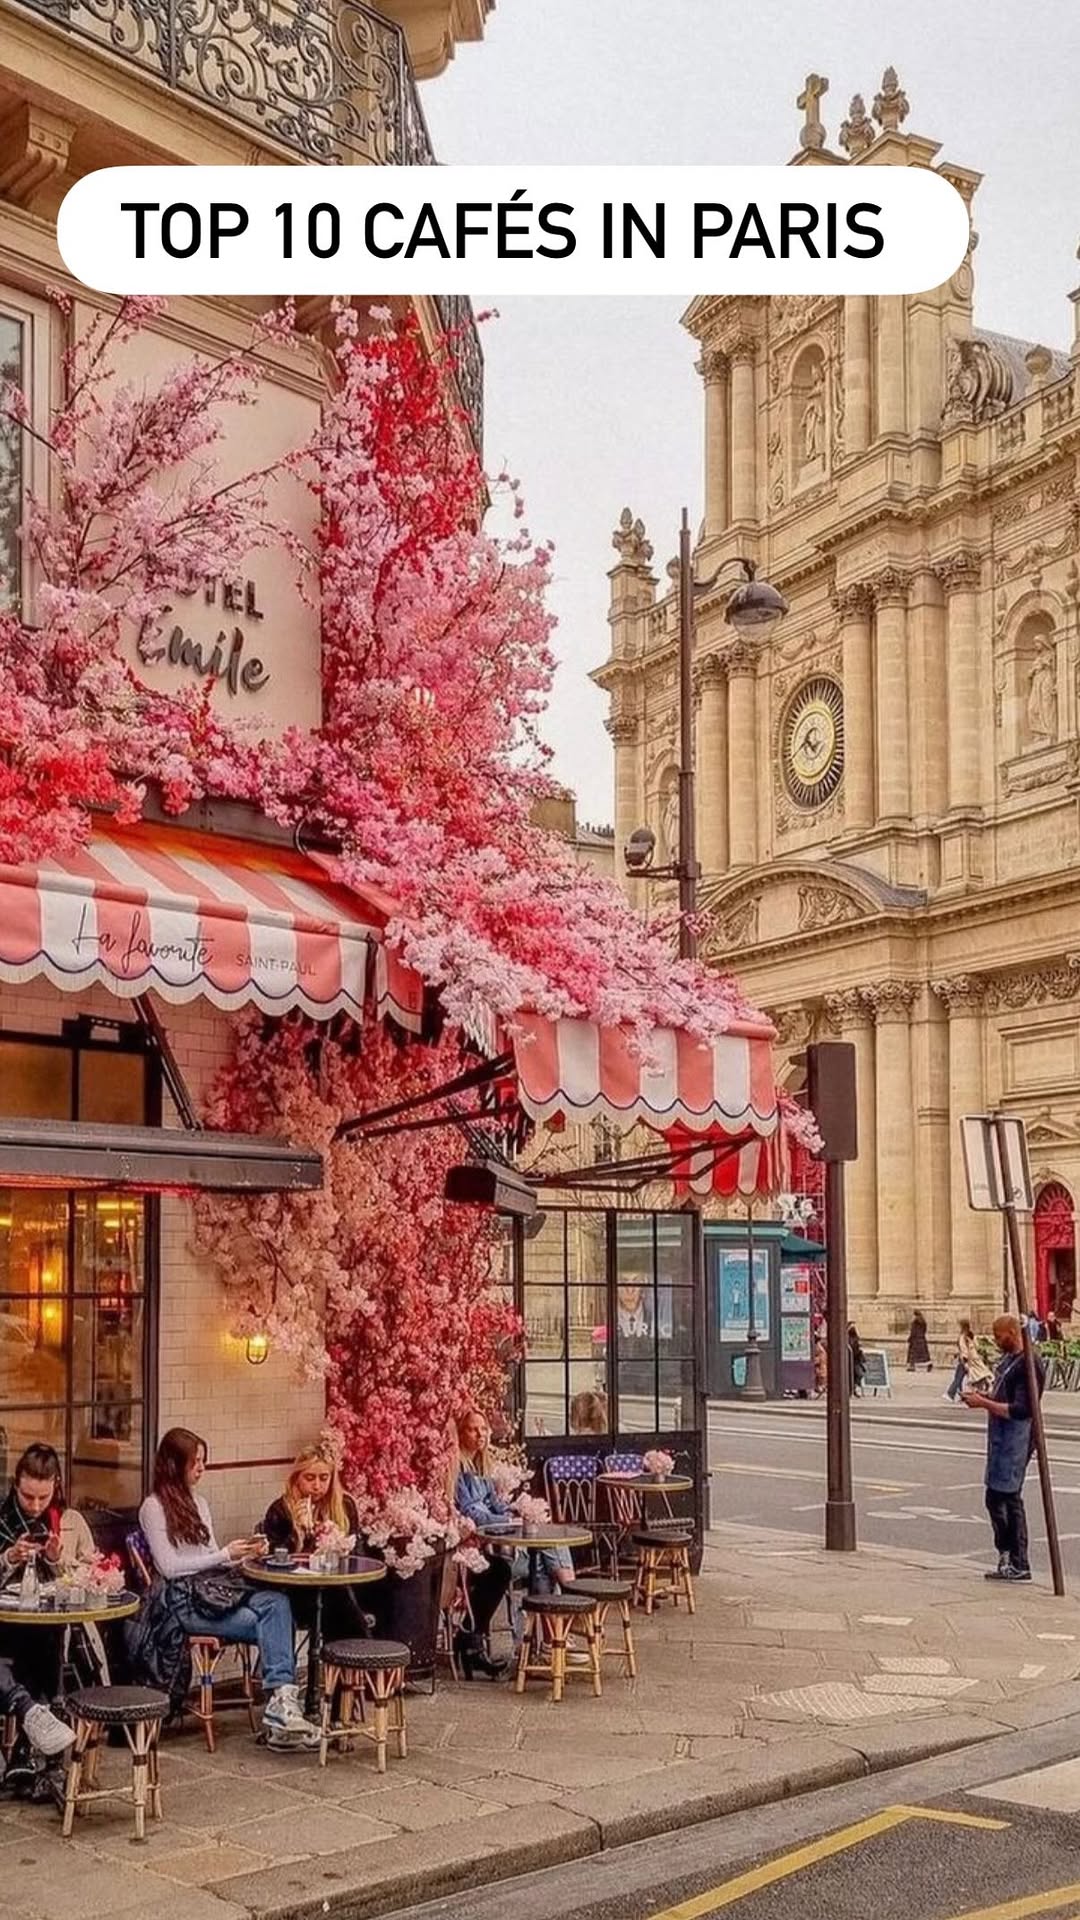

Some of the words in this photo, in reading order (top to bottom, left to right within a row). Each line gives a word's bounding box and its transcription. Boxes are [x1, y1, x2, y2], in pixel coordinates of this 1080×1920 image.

[71, 902, 117, 955] La
[121, 910, 216, 974] favorite
[235, 953, 317, 977] SAINT-PAUL
